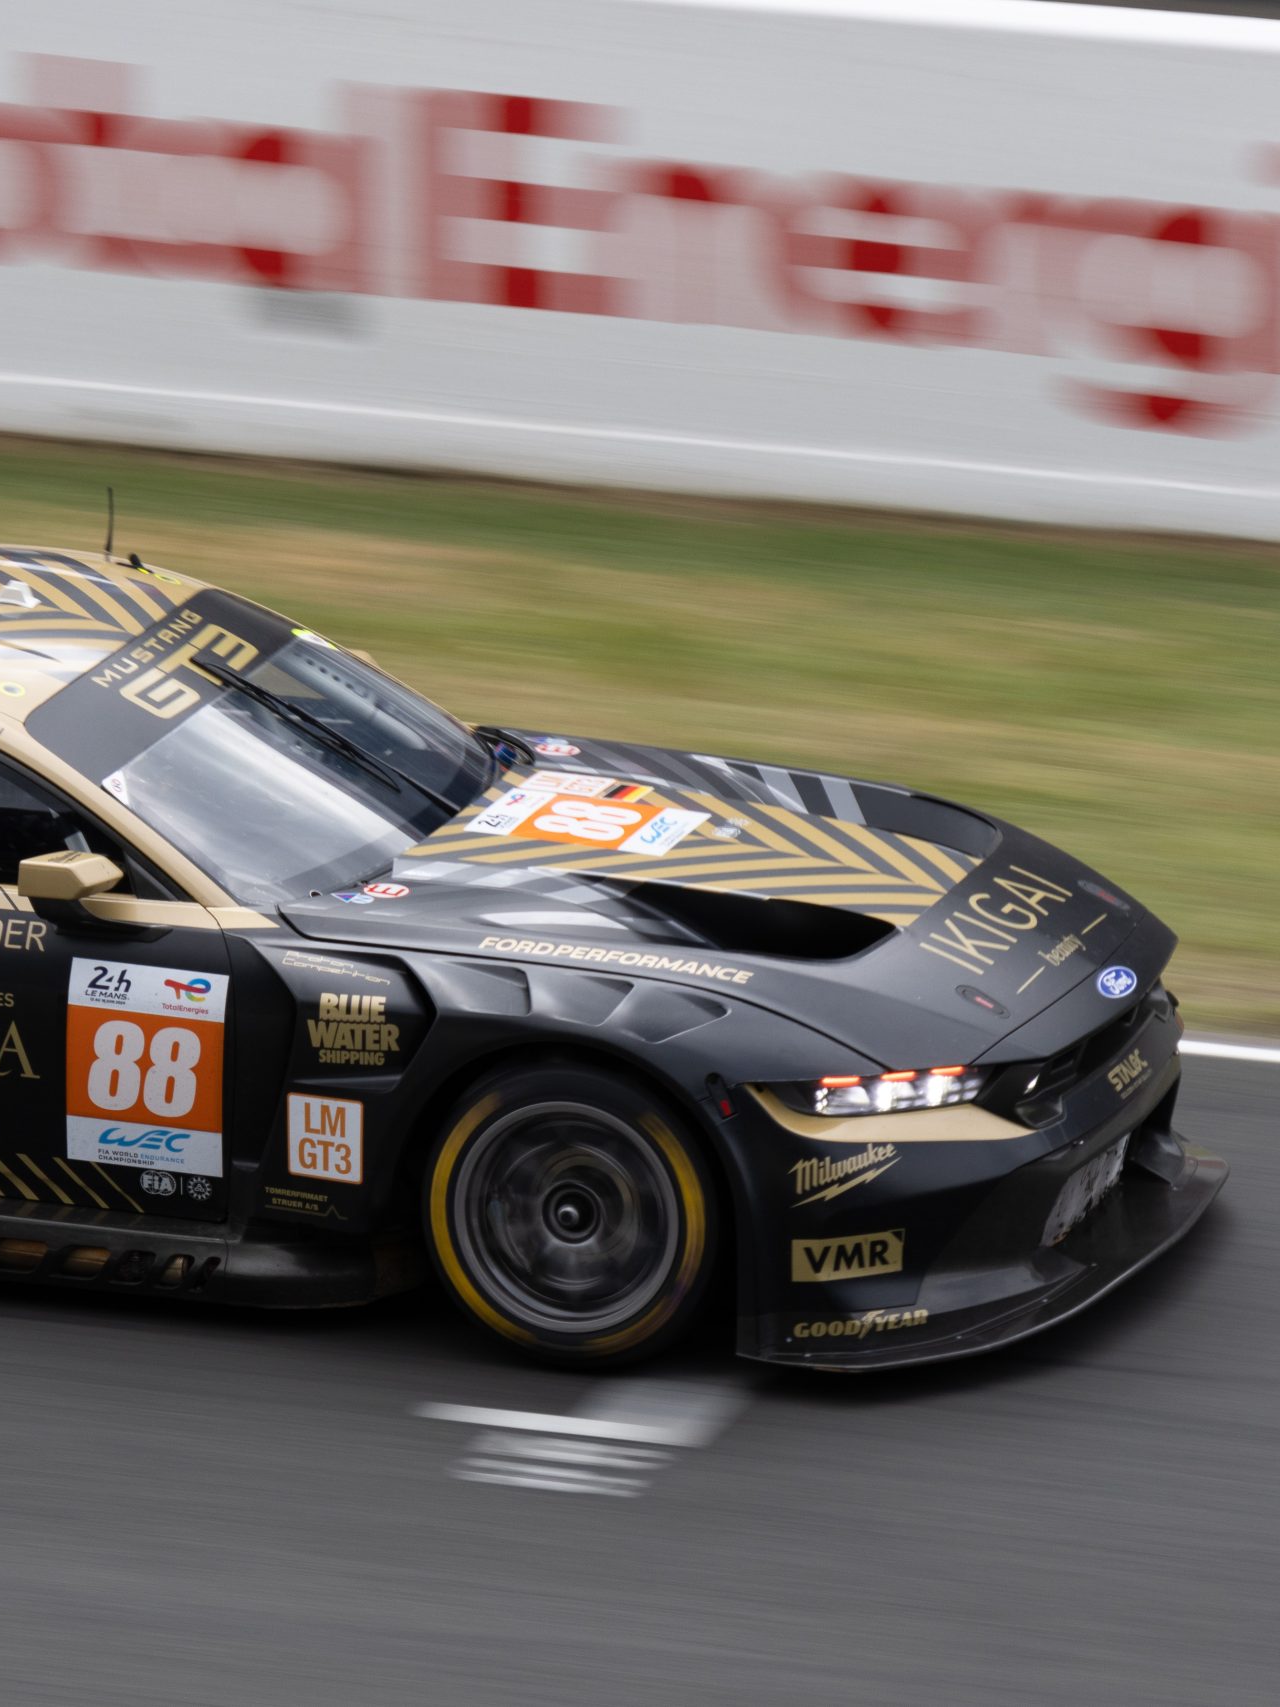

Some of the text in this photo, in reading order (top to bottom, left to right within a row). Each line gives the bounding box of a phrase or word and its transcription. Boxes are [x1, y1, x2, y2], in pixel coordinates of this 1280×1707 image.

[91, 608, 203, 688] MUSTANG
[119, 623, 259, 719] GT3
[533, 800, 643, 841] 88
[919, 864, 1073, 976] IKIGAI
[84, 989, 98, 997] LE
[87, 965, 132, 993] 24h
[1102, 970, 1134, 996] Ford
[161, 1002, 209, 1015] TotalEnergies
[319, 992, 387, 1023] BLUE
[307, 1019, 400, 1052] WATER
[87, 1019, 201, 1118] 88
[318, 1048, 386, 1066] SHIPPING
[304, 1101, 346, 1138] LM
[98, 1127, 192, 1153] WEC
[98, 1148, 185, 1164] FIA WORLD ENDURANCE
[98, 1154, 155, 1166] CHAMPIONSHIP
[298, 1137, 352, 1175] GT3
[788, 1143, 898, 1195] Milwaukee
[141, 1173, 173, 1194] FIA
[803, 1239, 890, 1275] VMR
[793, 1309, 929, 1340] GOODYEAR
